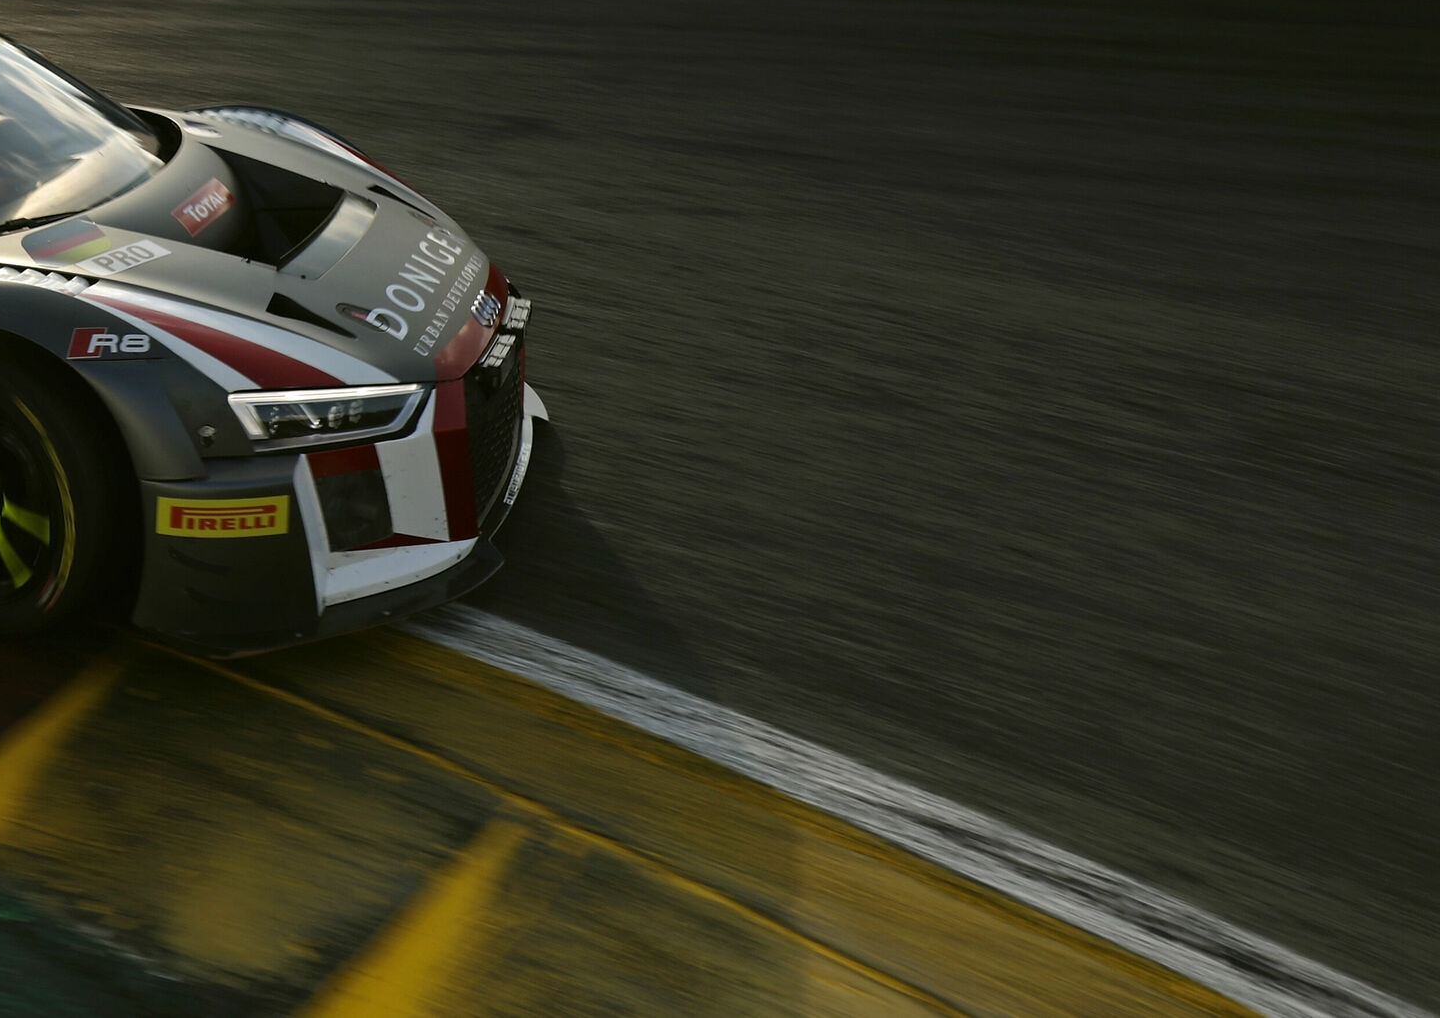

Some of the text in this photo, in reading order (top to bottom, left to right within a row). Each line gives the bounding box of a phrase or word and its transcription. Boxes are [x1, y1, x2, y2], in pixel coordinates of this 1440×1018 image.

[183, 190, 228, 223] TOTAL
[91, 244, 156, 273] PRO
[86, 333, 151, 353] R8
[412, 312, 450, 357] URBAN
[169, 503, 278, 532] PIRELLI
